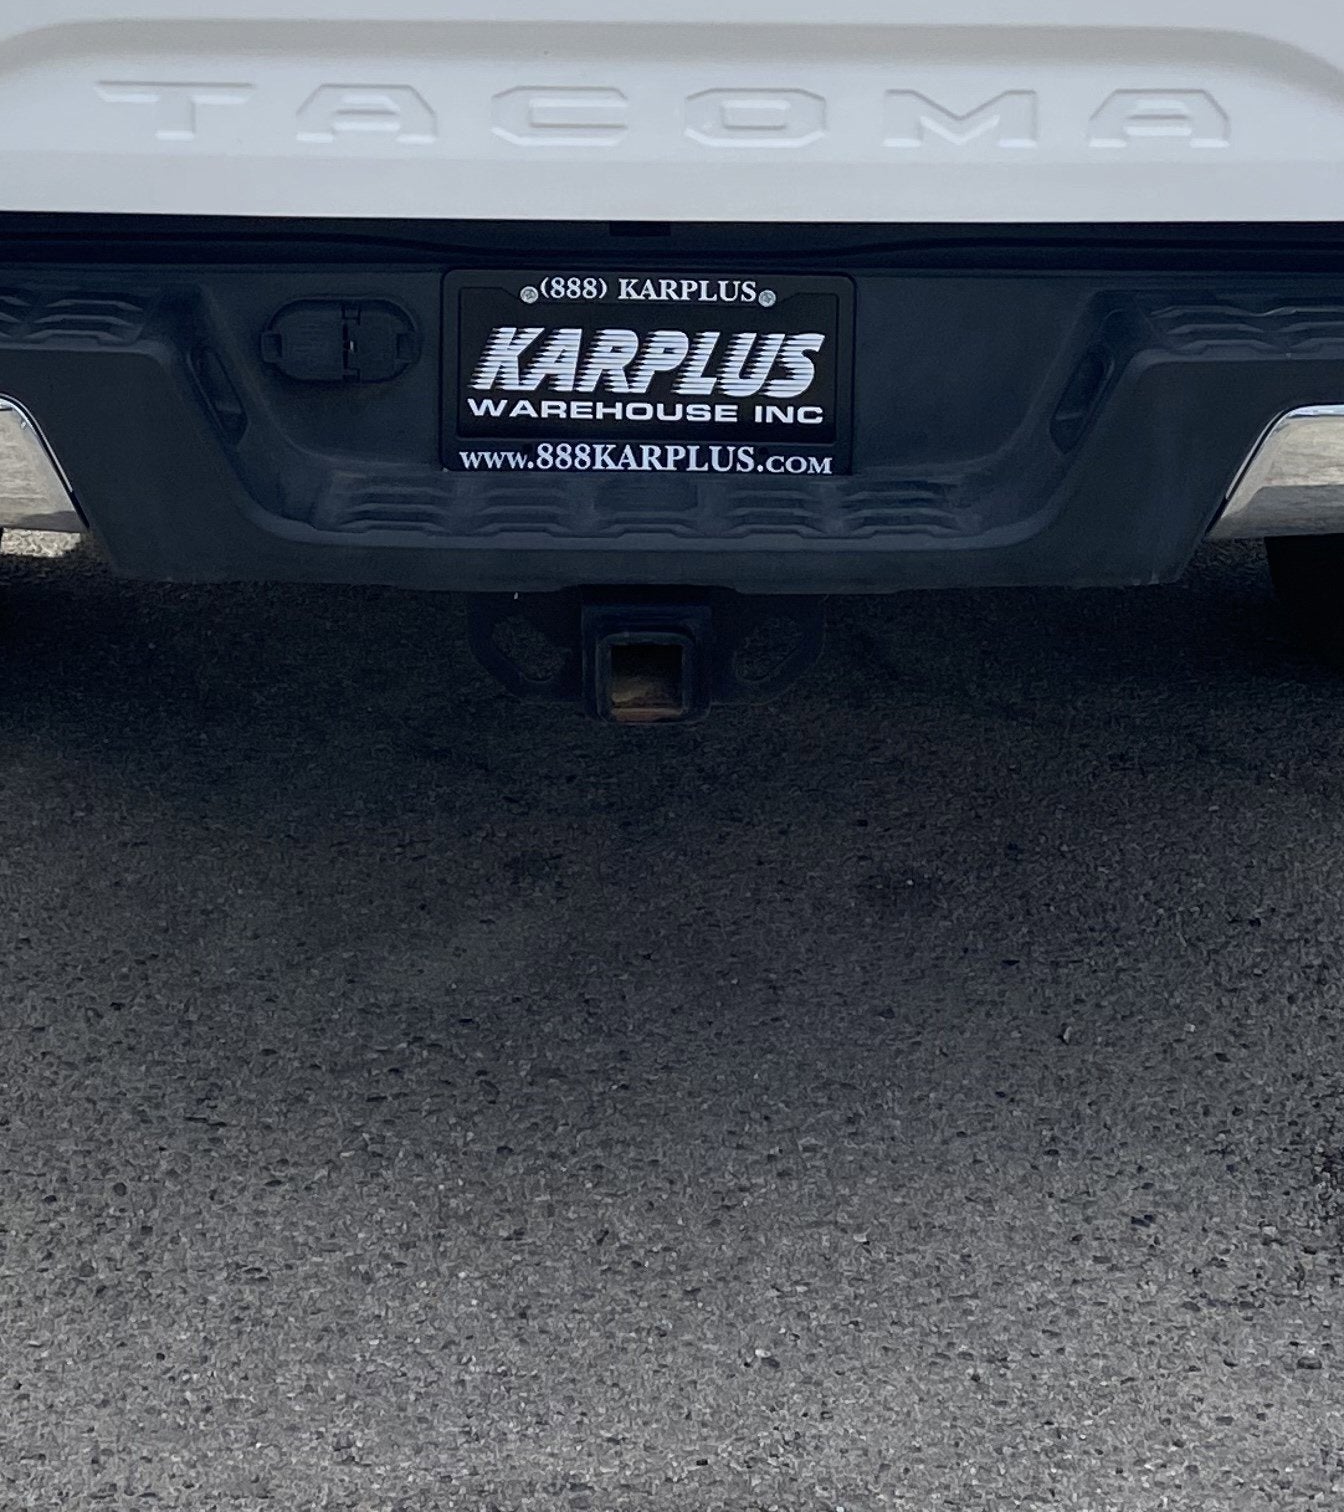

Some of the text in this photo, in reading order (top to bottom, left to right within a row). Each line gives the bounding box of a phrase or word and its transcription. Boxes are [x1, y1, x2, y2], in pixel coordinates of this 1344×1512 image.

[96, 80, 1232, 149] TACOMA
[540, 276, 757, 303] (888) KARPLUS
[468, 326, 825, 399] KARPLUS
[467, 398, 824, 424] WAREHOUSE INC
